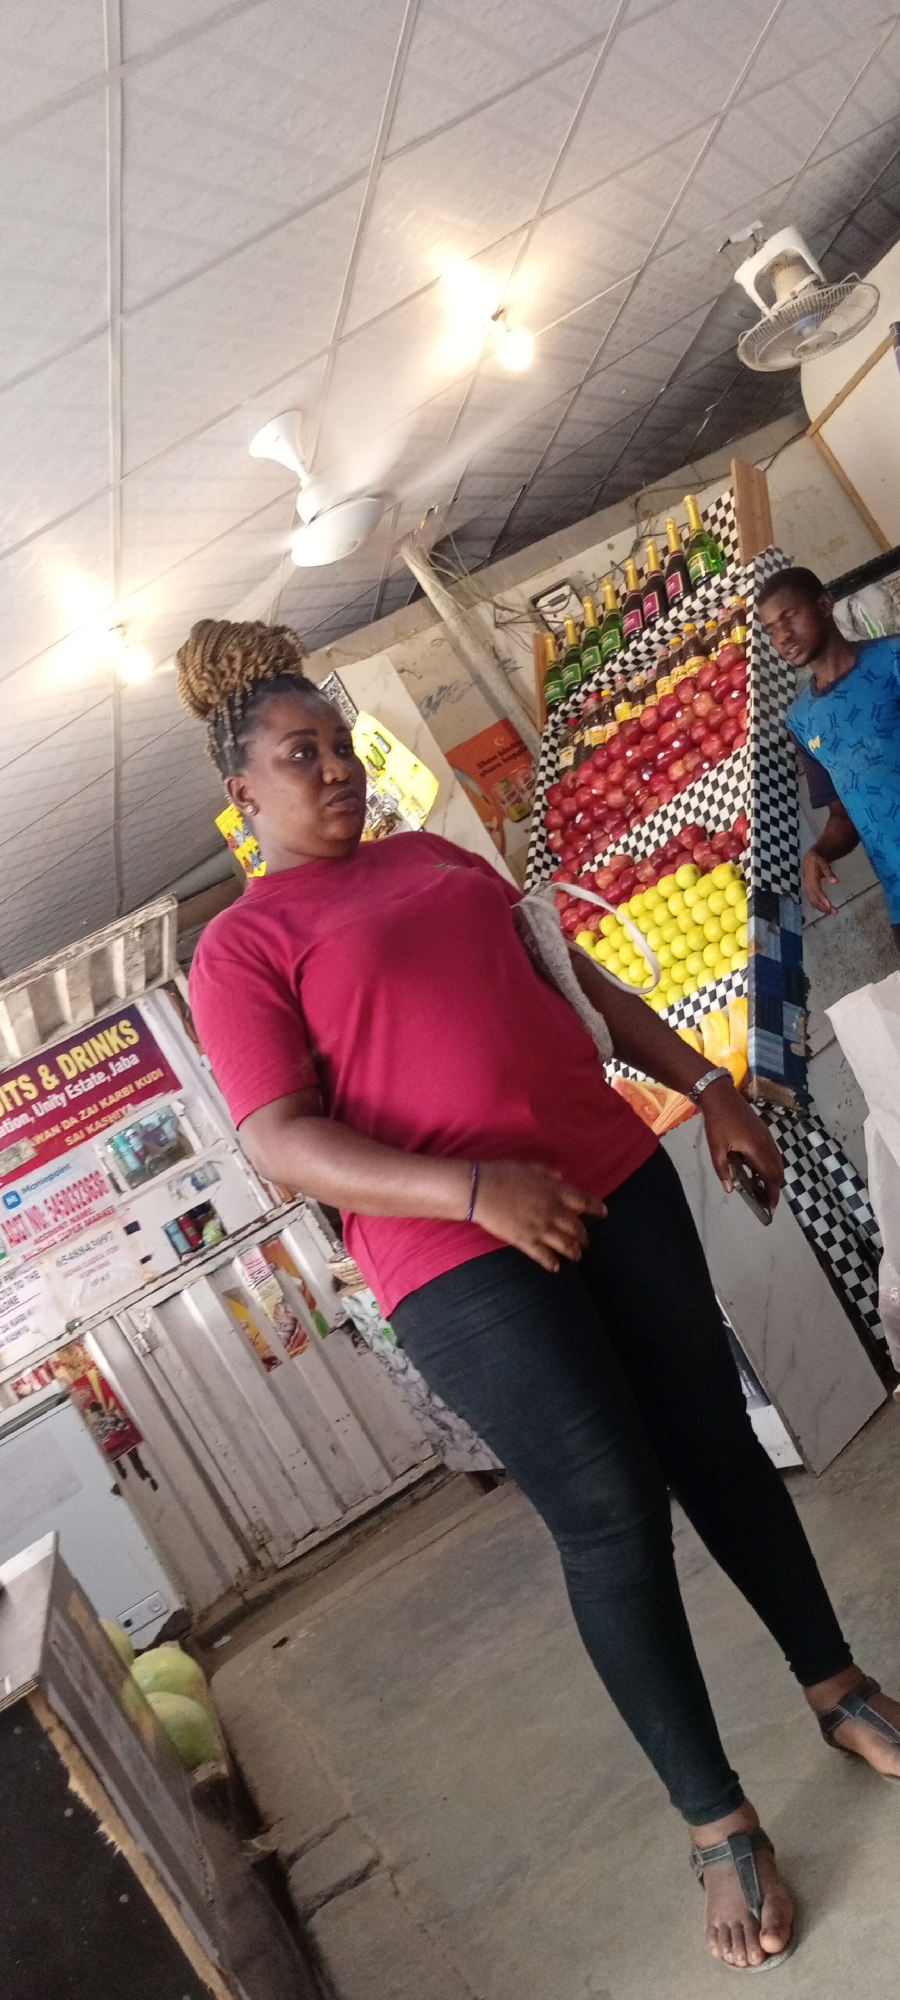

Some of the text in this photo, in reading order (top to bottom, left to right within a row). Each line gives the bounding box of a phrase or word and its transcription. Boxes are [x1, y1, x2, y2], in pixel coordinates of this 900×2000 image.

[37, 1064, 61, 1091] &
[56, 1019, 140, 1080] DRINKS
[31, 1091, 67, 1117] Unity
[64, 1071, 112, 1100] Estate,
[108, 1053, 141, 1077] Jaba
[60, 1116, 79, 1130] DA
[78, 1104, 99, 1120] ZAI
[99, 1087, 135, 1109] KARBI
[134, 1068, 165, 1089] KUDI
[65, 1103, 136, 1146] SAI KASHIYA
[21, 1163, 73, 1195] Moniepoint
[24, 1270, 41, 1284] THE
